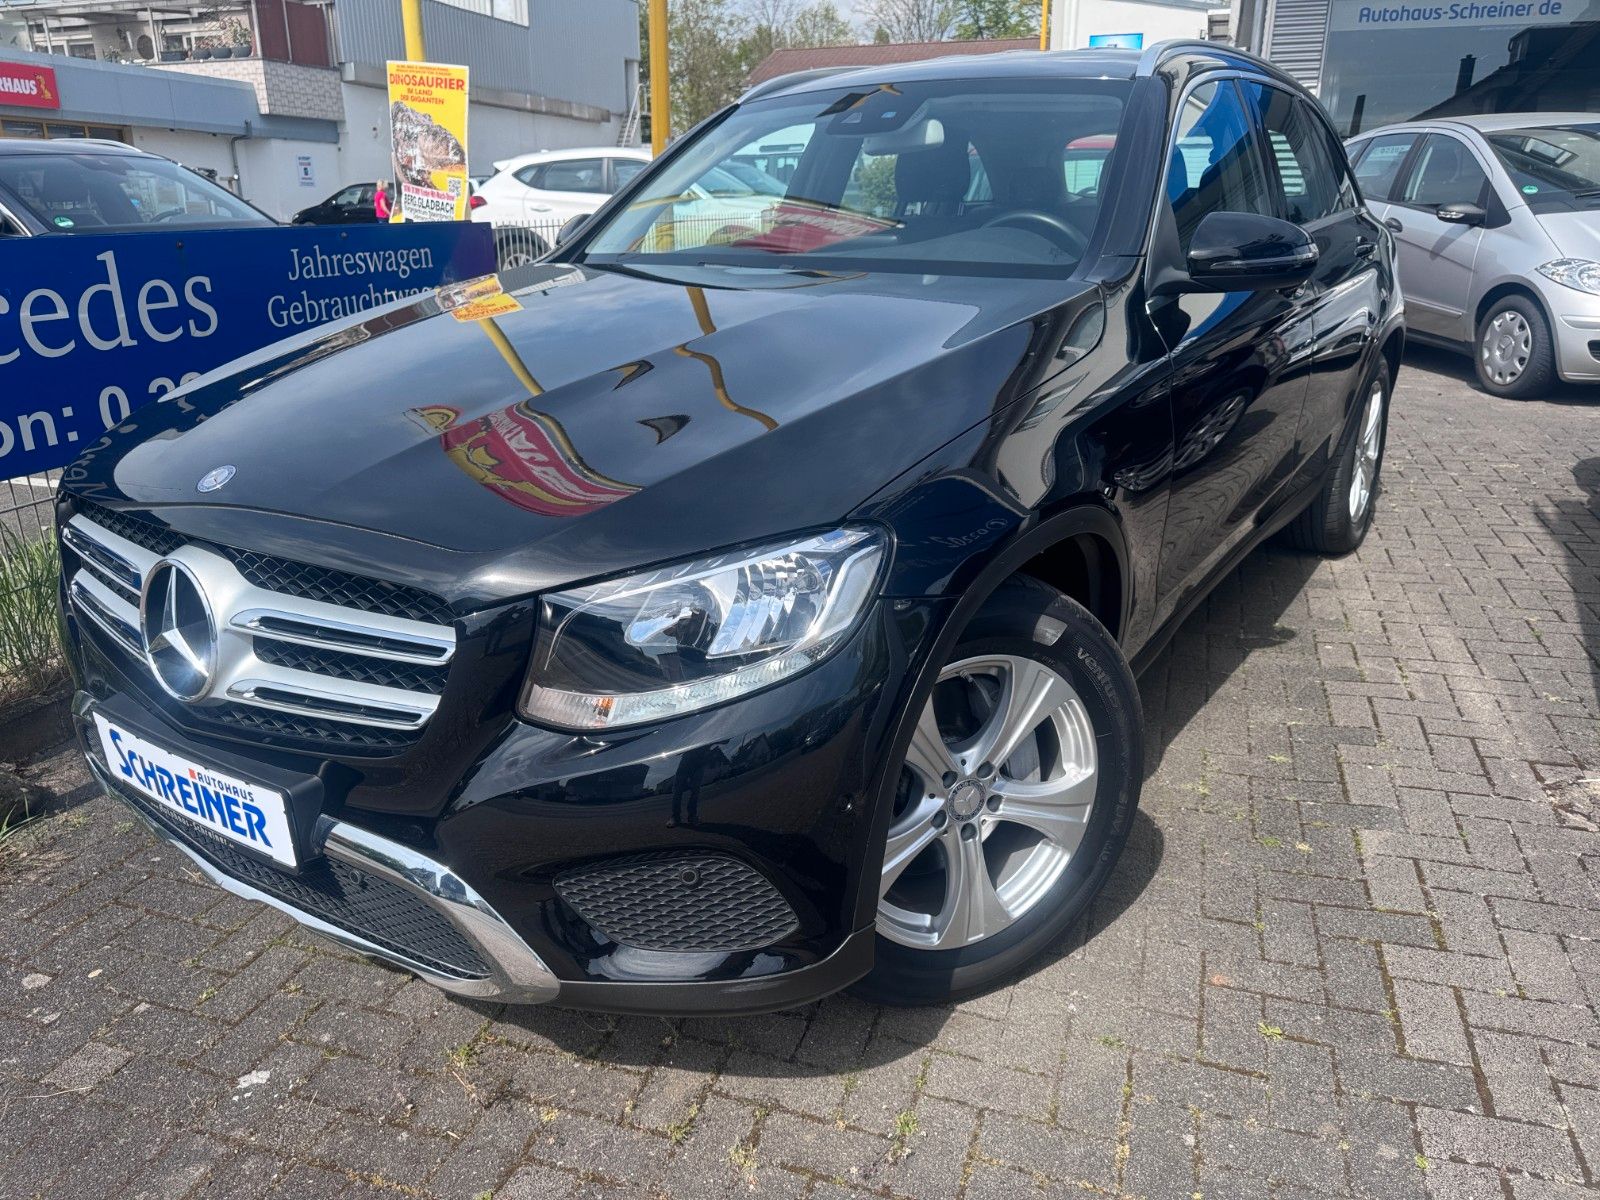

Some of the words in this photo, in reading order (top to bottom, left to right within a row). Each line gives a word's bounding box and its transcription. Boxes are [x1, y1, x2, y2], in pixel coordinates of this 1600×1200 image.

[1358, 2, 1562, 23] Autohaus-Schreiner.de
[0, 77, 37, 95] HAUS
[389, 73, 465, 91] DINOSAURIER
[410, 95, 445, 105] GIGANTEN
[288, 245, 434, 281] Jahreswagen
[109, 728, 273, 848] SCHREINER
[197, 771, 254, 802] AUTOHAUS
